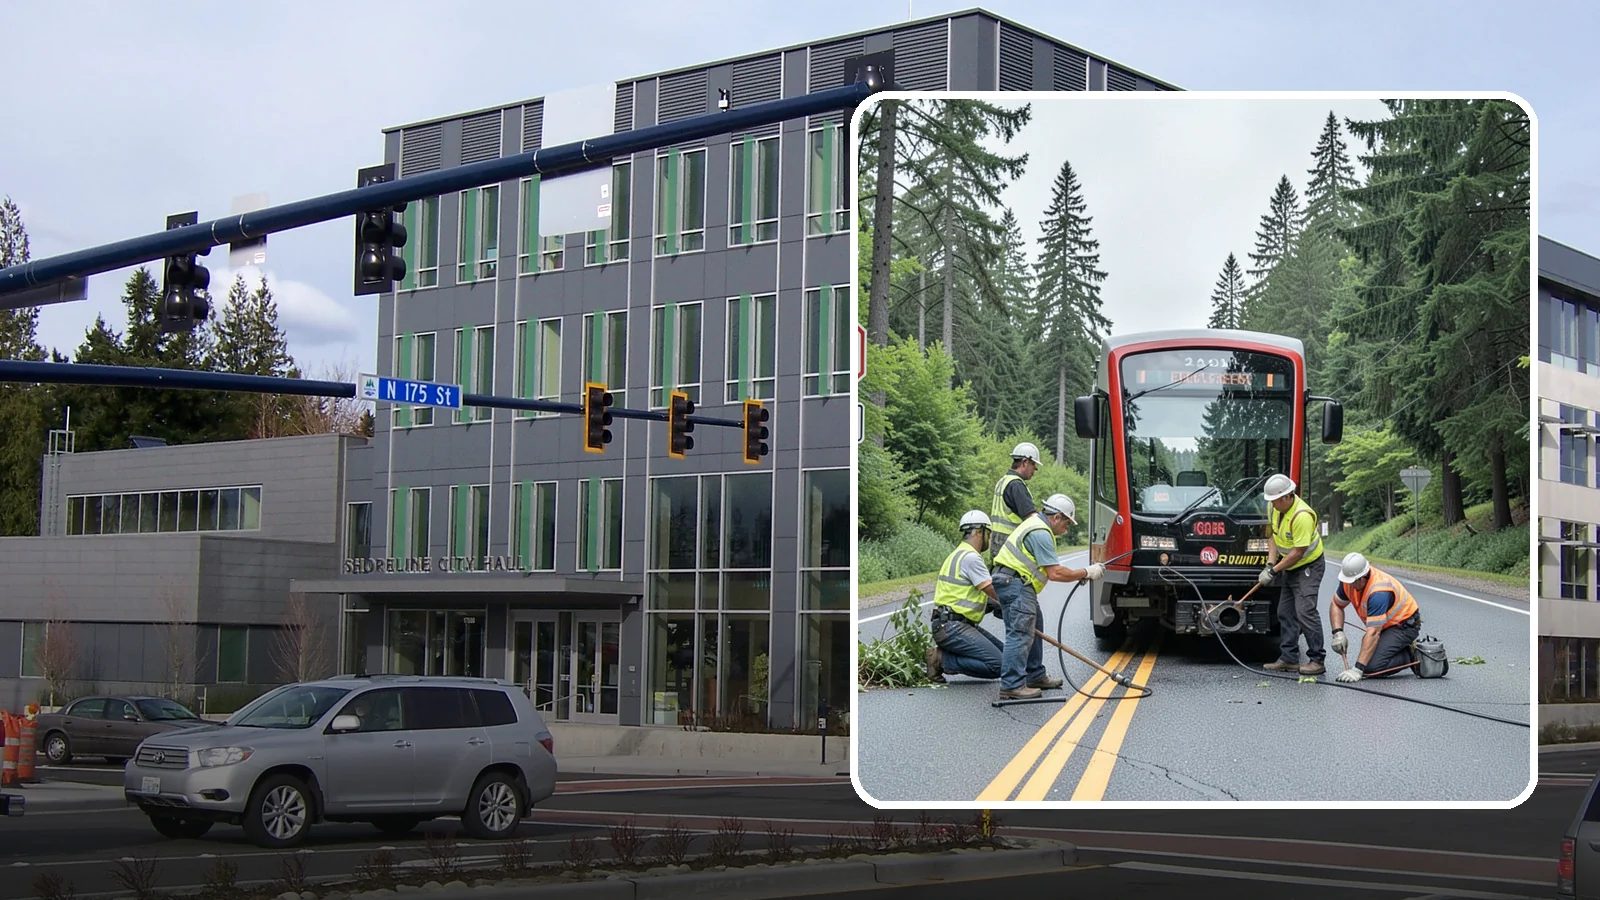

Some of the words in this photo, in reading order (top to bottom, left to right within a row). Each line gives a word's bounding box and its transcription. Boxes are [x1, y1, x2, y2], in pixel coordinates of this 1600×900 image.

[387, 380, 396, 399] N
[405, 382, 427, 403] 175
[436, 386, 451, 406] St
[343, 557, 432, 574] SHORELINE
[438, 556, 476, 572] CITY
[484, 555, 525, 571] HALL
